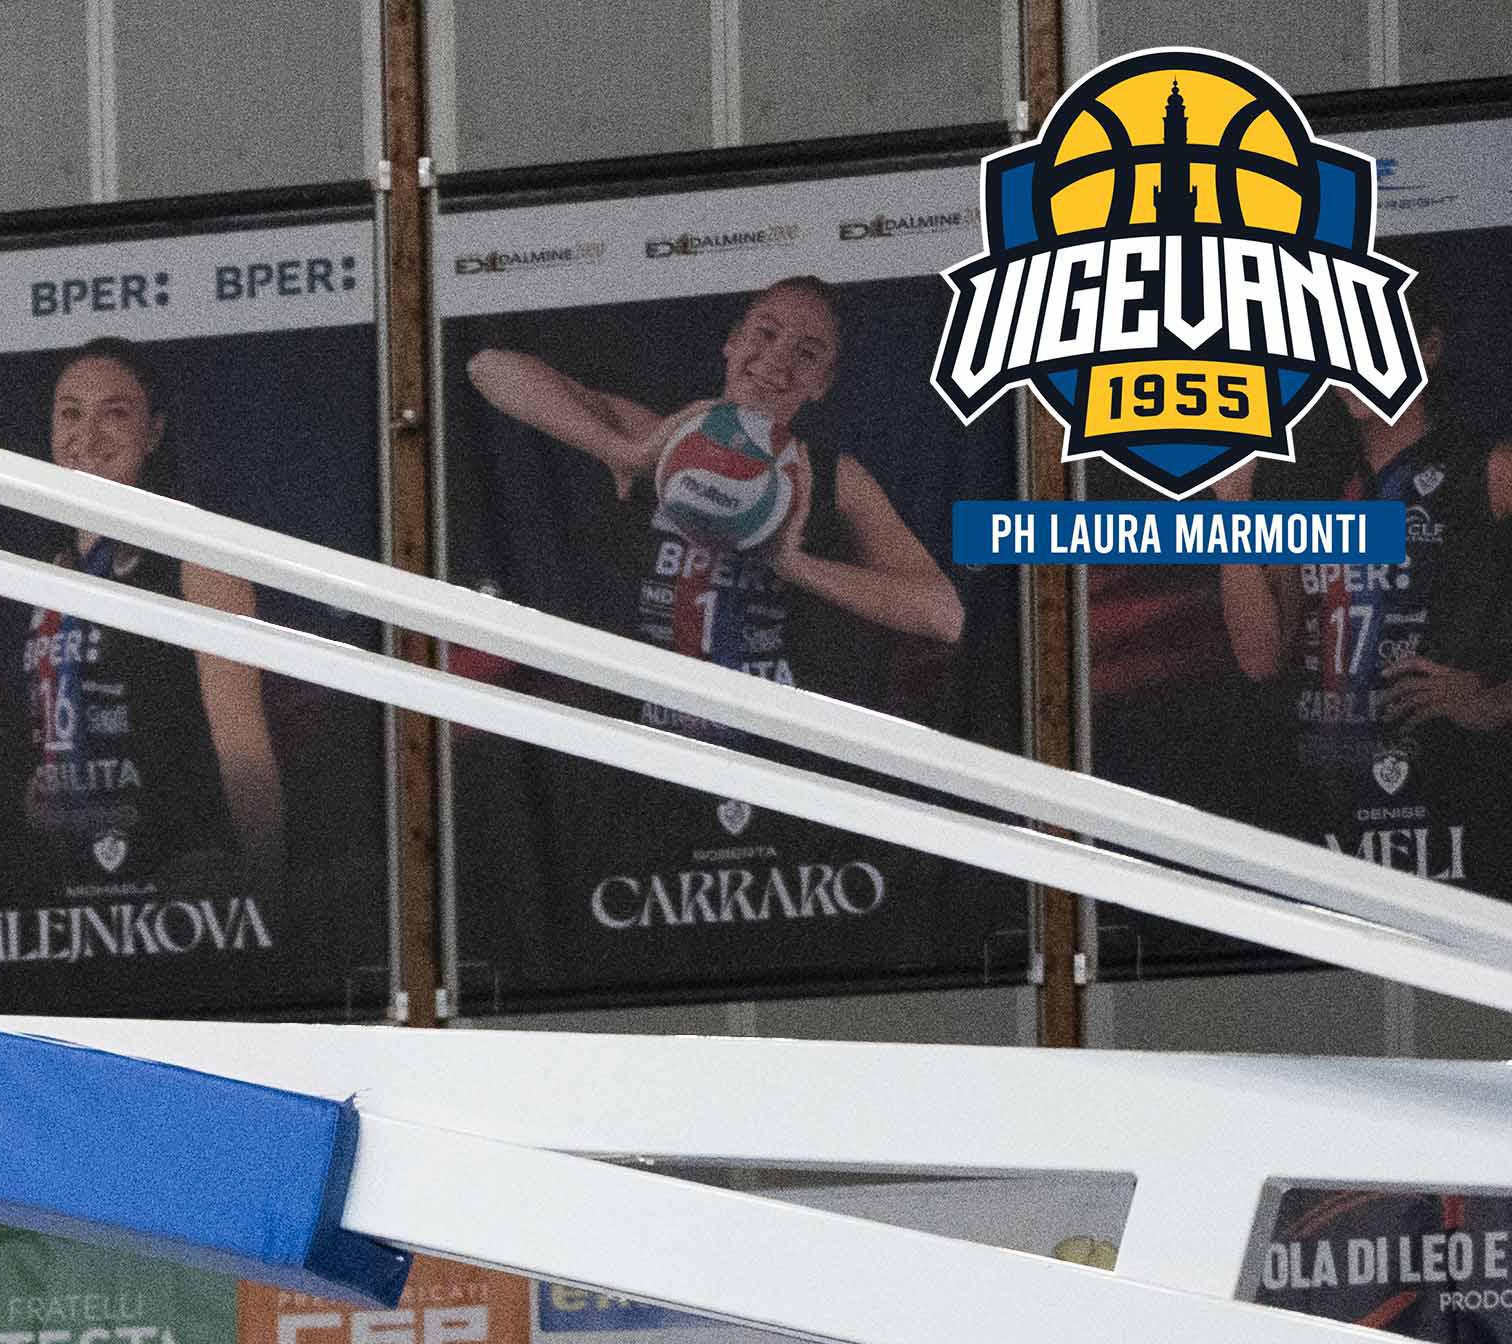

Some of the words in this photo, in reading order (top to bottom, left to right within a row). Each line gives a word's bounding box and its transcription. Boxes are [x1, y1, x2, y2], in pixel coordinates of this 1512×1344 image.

[1329, 603, 1373, 676] 17
[588, 861, 887, 931] CARRARO
[1348, 1237, 1388, 1285] DI
[1399, 1232, 1474, 1283] LEO
[1484, 1231, 1508, 1279] E
[8, 1291, 145, 1323] FRATELLI
